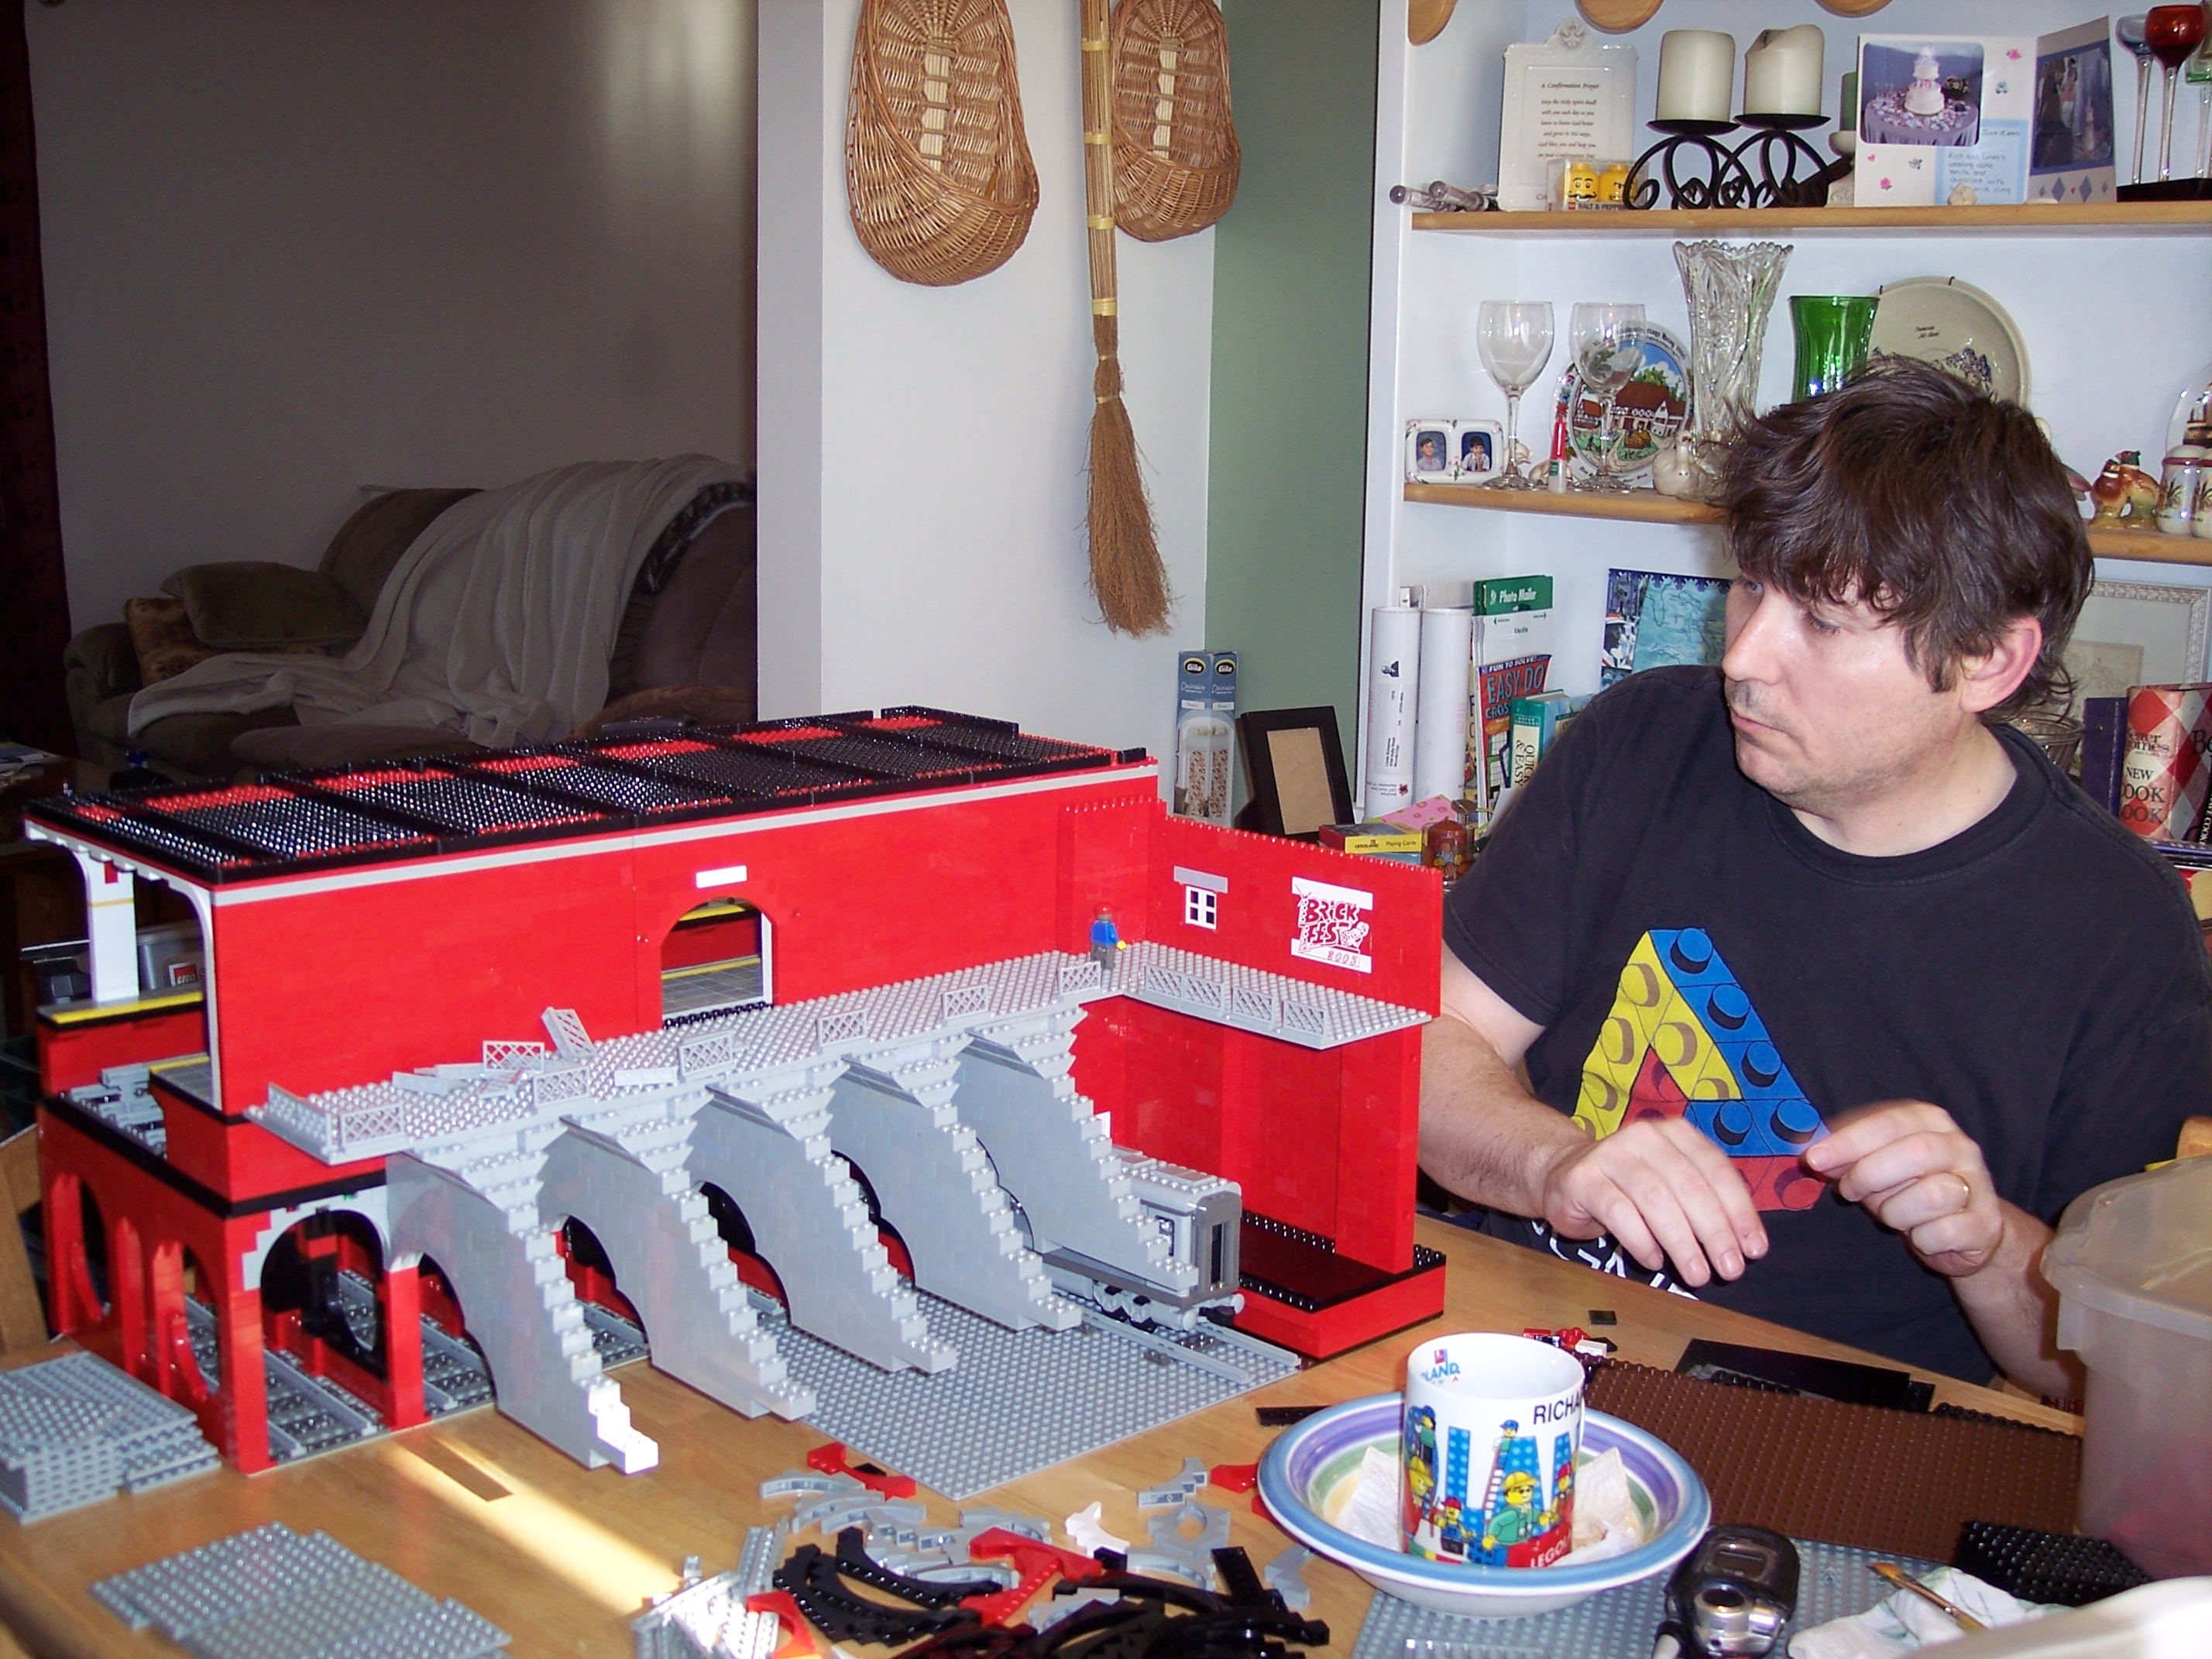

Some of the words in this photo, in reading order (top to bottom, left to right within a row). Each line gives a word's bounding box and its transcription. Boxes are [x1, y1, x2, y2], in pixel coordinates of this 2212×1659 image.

[1499, 589, 1517, 603] Photo
[1518, 586, 1537, 601] Mailer
[1489, 663, 1503, 673] FUN
[1487, 669, 1520, 704] EASY
[1514, 754, 1524, 787] EASY
[2126, 767, 2155, 781] NEW
[2121, 803, 2166, 824] OOK
